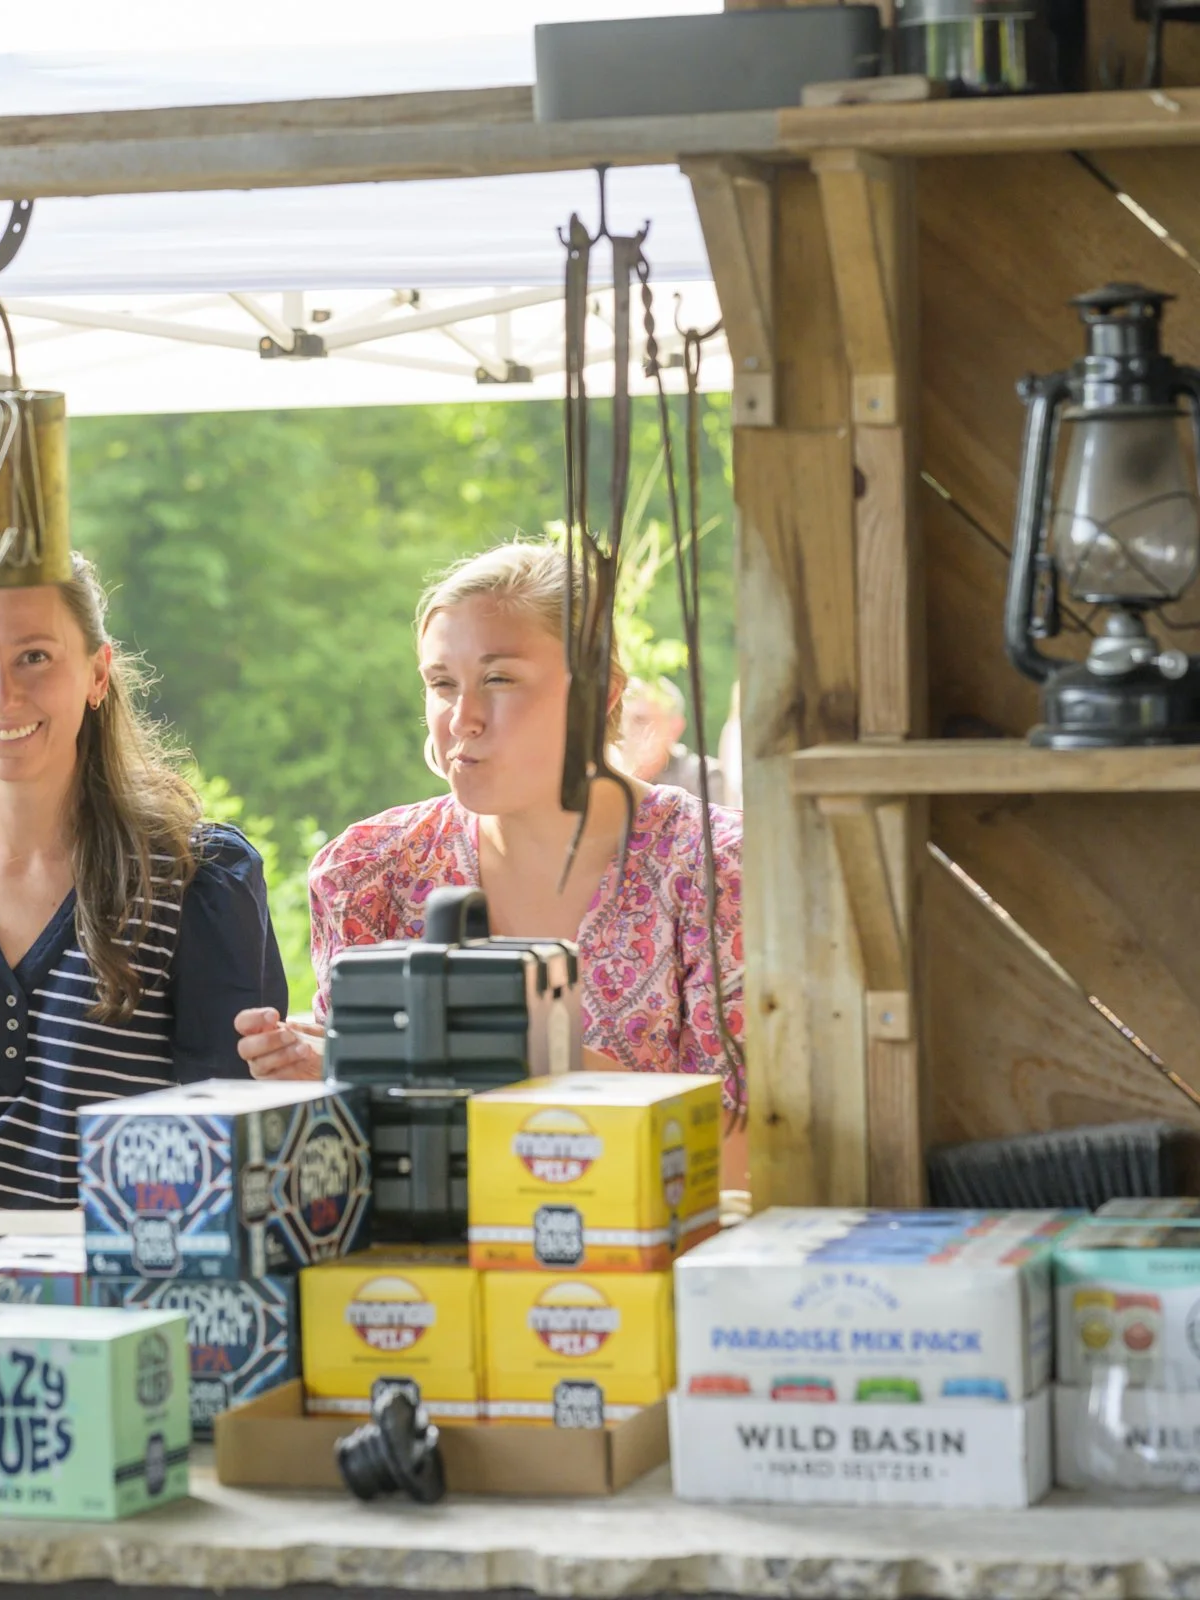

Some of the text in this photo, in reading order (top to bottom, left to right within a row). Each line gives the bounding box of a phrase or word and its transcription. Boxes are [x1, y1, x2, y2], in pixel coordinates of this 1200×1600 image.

[116, 1121, 203, 1155] COSMIC
[115, 1148, 201, 1189] MUTANT
[135, 1182, 183, 1210] IPA
[711, 1328, 982, 1354] PARADISE MIX PACK
[737, 1424, 966, 1455] WILD BASIN
[769, 1460, 934, 1482] HARD SELTZER
